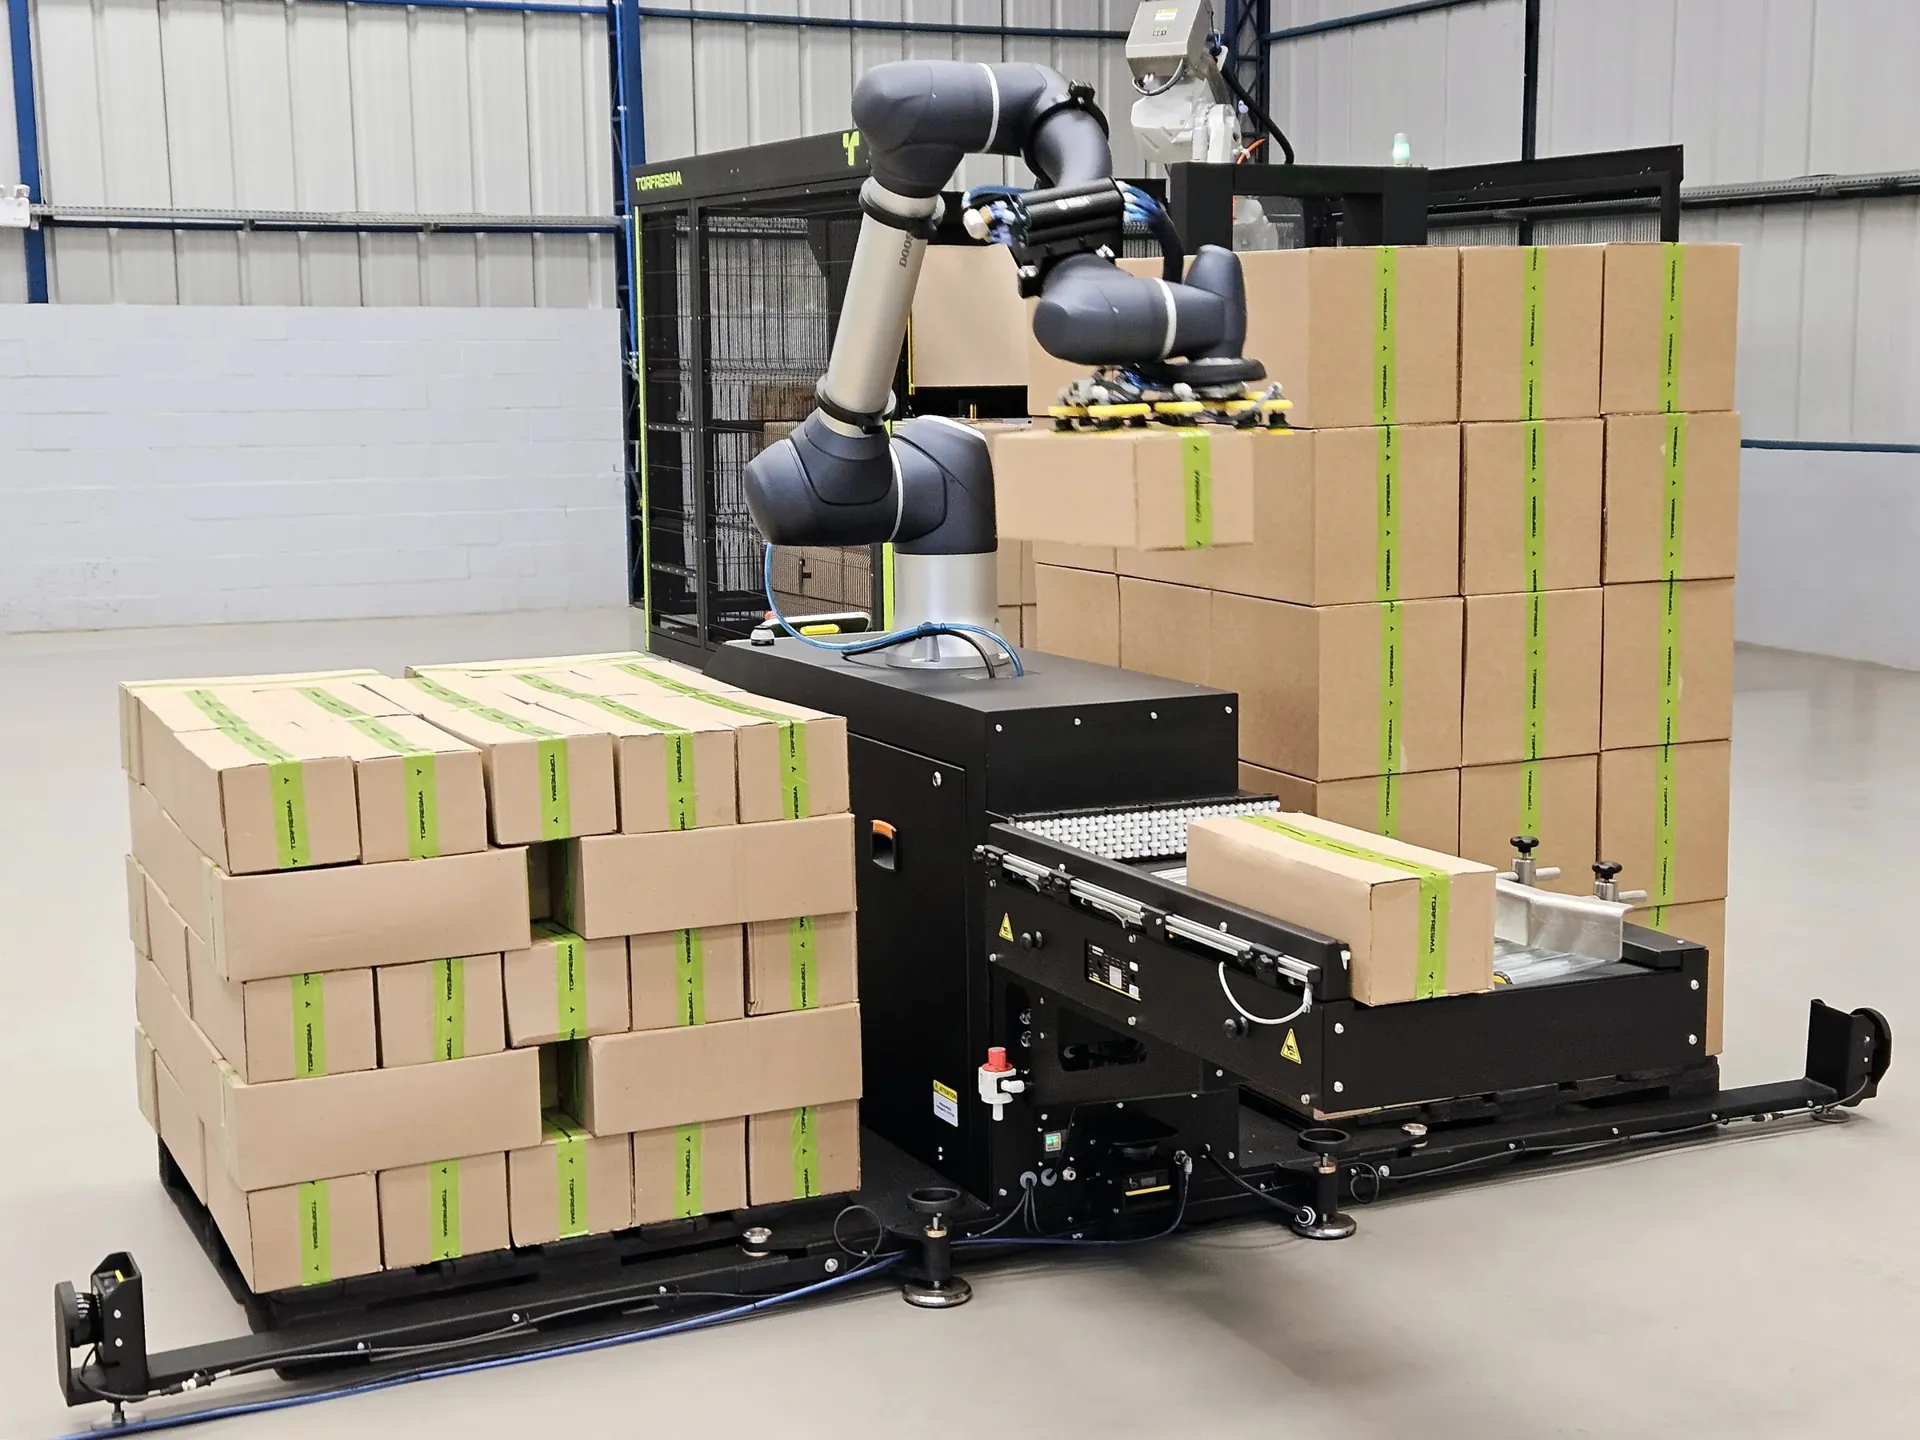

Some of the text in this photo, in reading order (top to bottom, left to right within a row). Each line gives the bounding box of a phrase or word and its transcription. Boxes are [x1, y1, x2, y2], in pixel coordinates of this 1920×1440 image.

[636, 171, 682, 191] TORFRESMA
[899, 232, 914, 268] DOOS
[549, 752, 557, 803] TORFRESMA
[675, 735, 683, 784] TORFRESMA
[288, 799, 296, 851] TORFRESMA
[418, 790, 426, 841] TORFRESMA
[1429, 894, 1437, 954] TORFRESMA
[567, 943, 575, 993] TORFRESMA
[801, 962, 809, 1009] TORFRESMA
[306, 1022, 314, 1074] TORFRESMA
[311, 1200, 319, 1250] TORFRESMA
